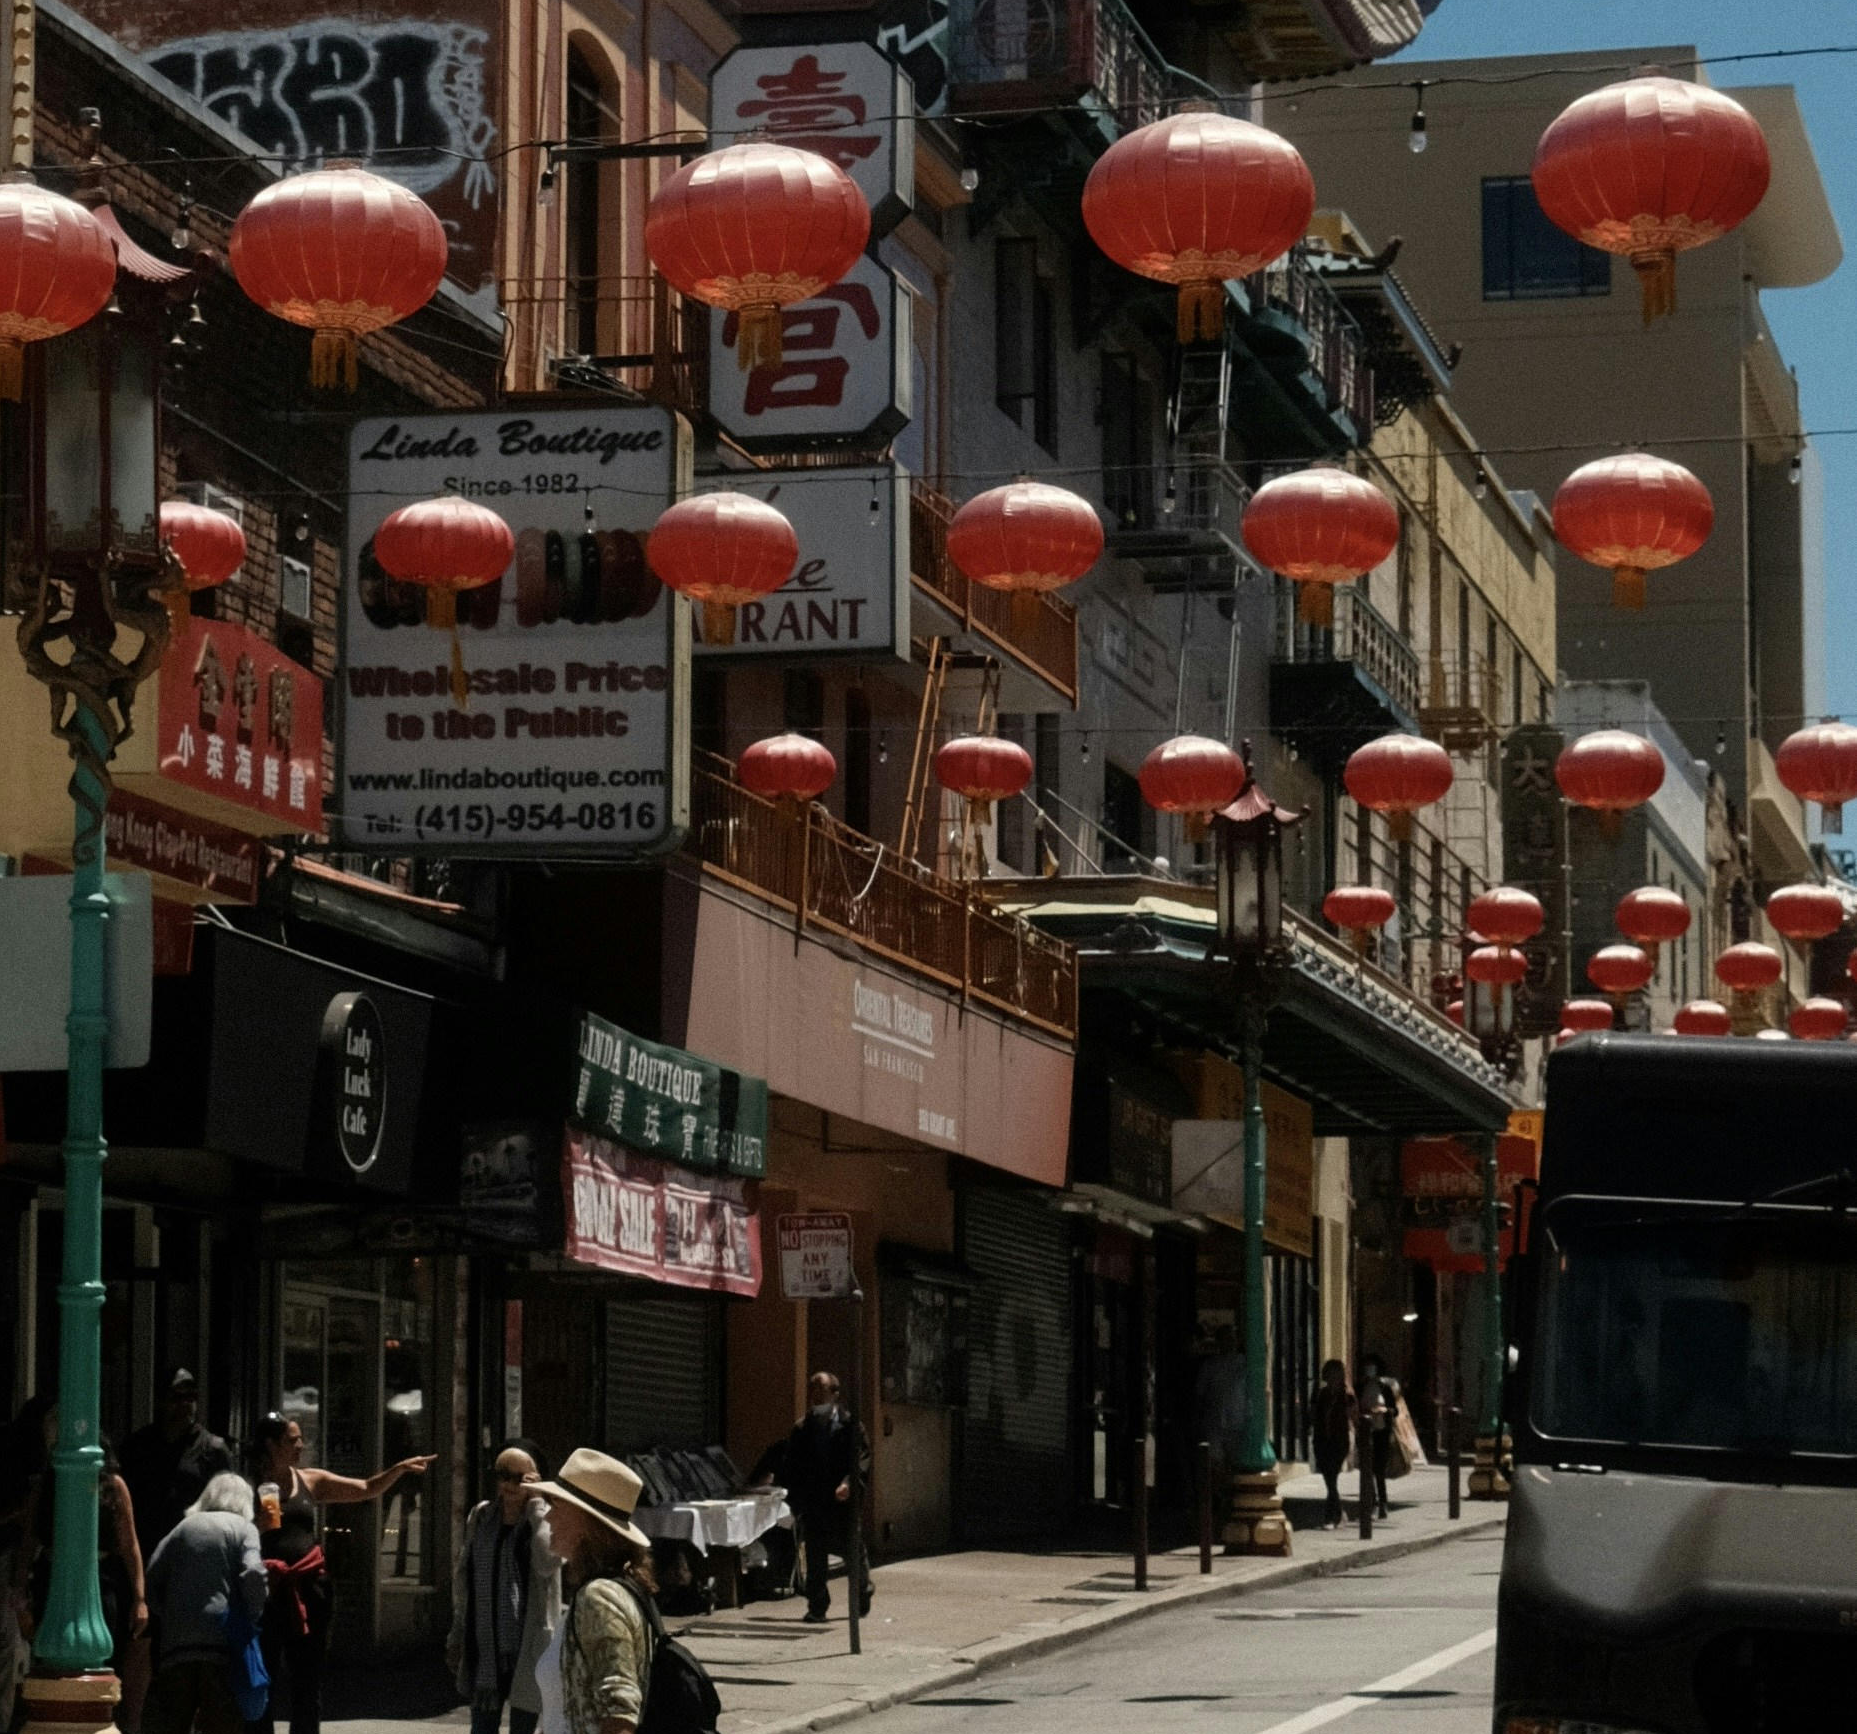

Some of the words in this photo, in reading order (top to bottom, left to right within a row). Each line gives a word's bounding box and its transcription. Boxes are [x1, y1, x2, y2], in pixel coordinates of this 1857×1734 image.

[359, 424, 479, 461] Linda
[498, 419, 663, 465] Boutique
[443, 476, 513, 497] Since
[521, 473, 580, 495] 1982
[565, 660, 669, 693] Price
[387, 713, 425, 741] to
[433, 708, 496, 740] the
[505, 705, 628, 740] Public
[349, 766, 665, 793] www.lindaboutique.com
[415, 802, 656, 840] (415)-954-0816
[346, 1026, 373, 1065] Lady
[578, 1019, 621, 1077] LINDA
[626, 1045, 702, 1106] BOUTIQUE
[344, 1066, 372, 1098] Luck
[343, 1104, 367, 1136] Cafe
[781, 1230, 799, 1248] NO
[802, 1233, 847, 1248] STOPPING
[802, 1252, 828, 1266] ANY
